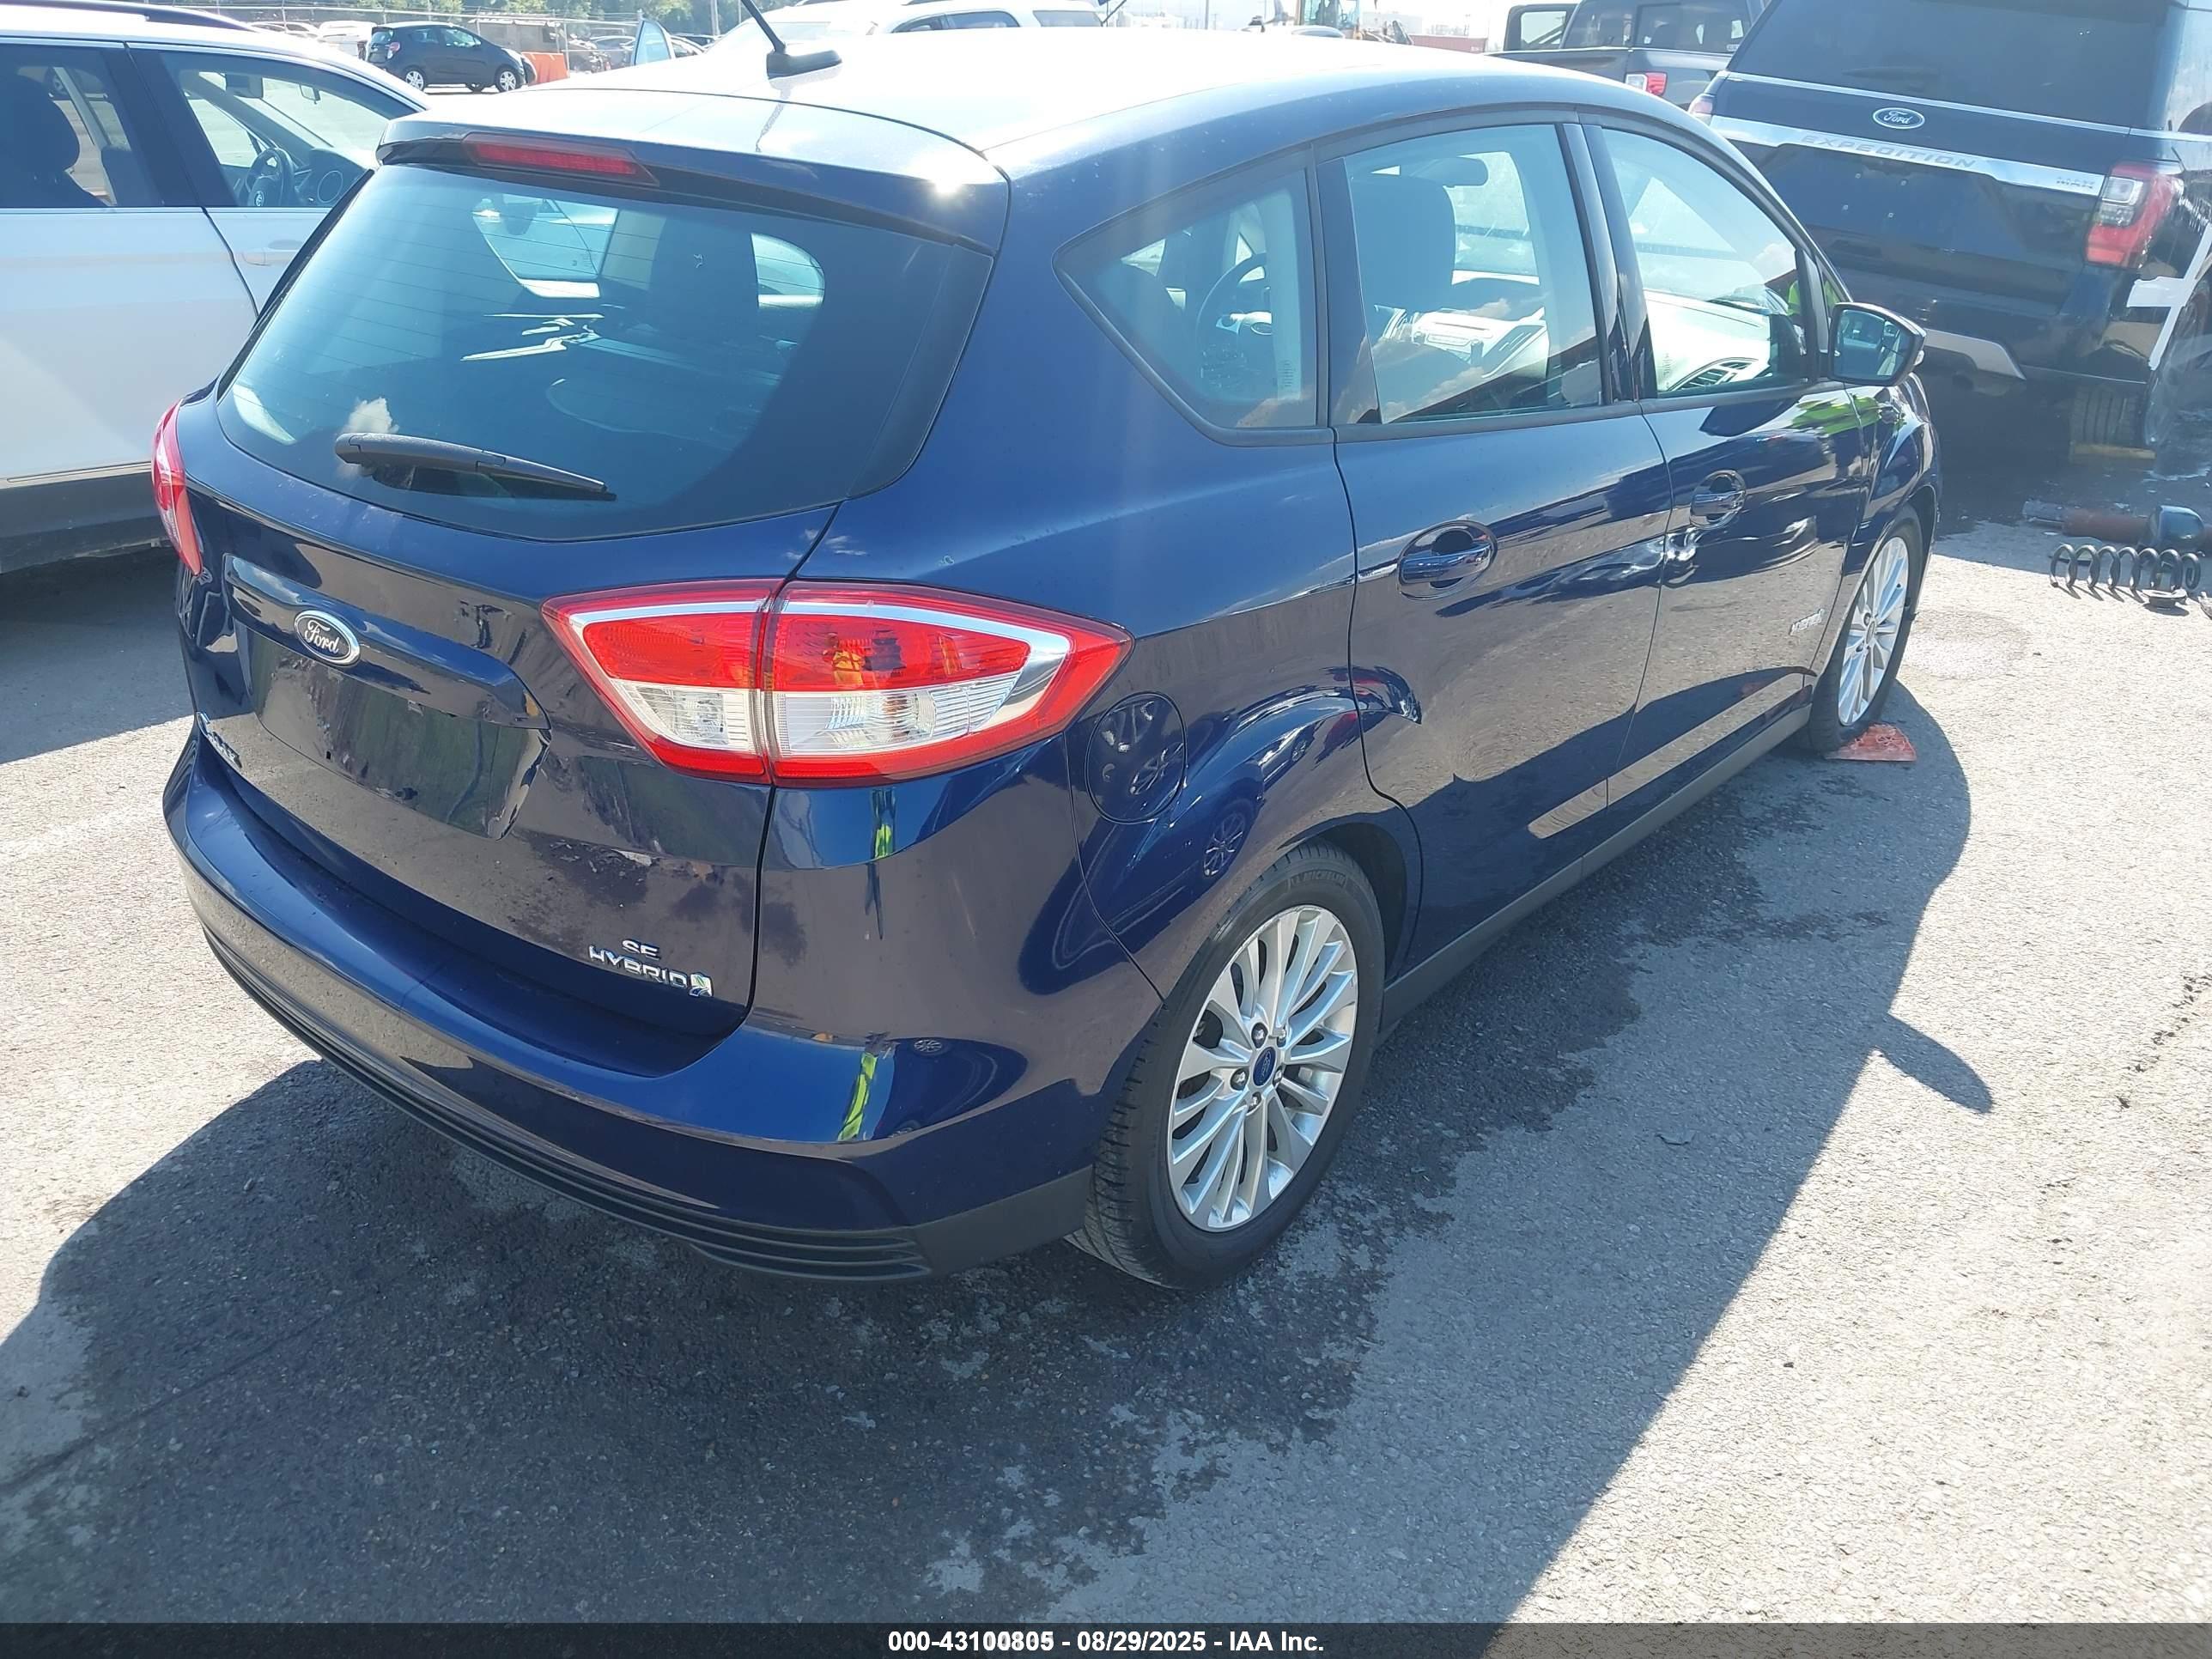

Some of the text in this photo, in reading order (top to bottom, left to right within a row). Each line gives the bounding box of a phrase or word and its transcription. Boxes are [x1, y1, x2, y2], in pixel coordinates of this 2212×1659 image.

[1883, 110, 1913, 125] Ford
[1802, 134, 1976, 168] EXPEDITION
[304, 619, 340, 654] Ford
[589, 945, 689, 989] HYBRID
[622, 939, 661, 961] SE
